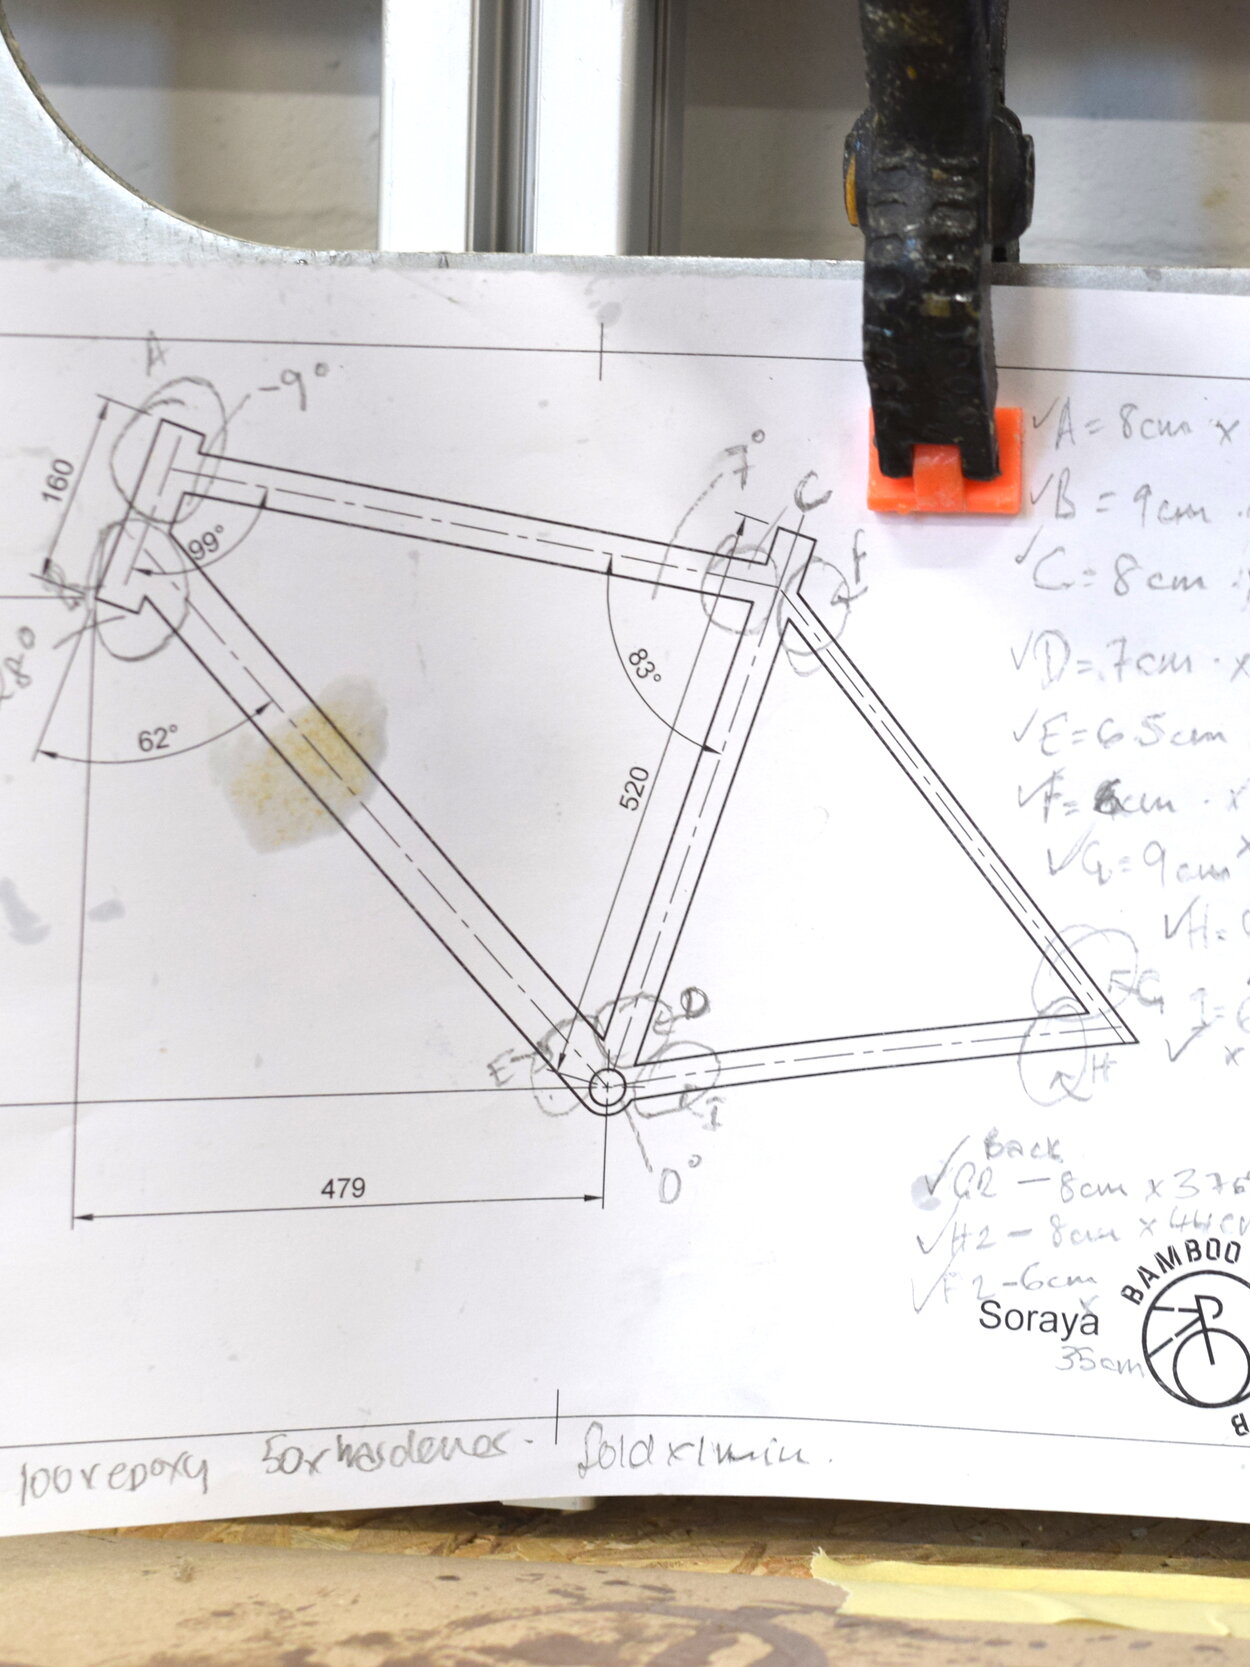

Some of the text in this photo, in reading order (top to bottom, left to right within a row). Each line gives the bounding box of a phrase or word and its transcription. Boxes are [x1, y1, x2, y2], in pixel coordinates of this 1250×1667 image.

[40, 458, 75, 504] 160
[628, 648, 662, 684] 83°
[138, 723, 180, 753] 62°
[619, 766, 650, 812] 520
[321, 1176, 367, 1200] 479
[1120, 1237, 1243, 1306] BAMBOO
[979, 1298, 1101, 1342] Soraya
